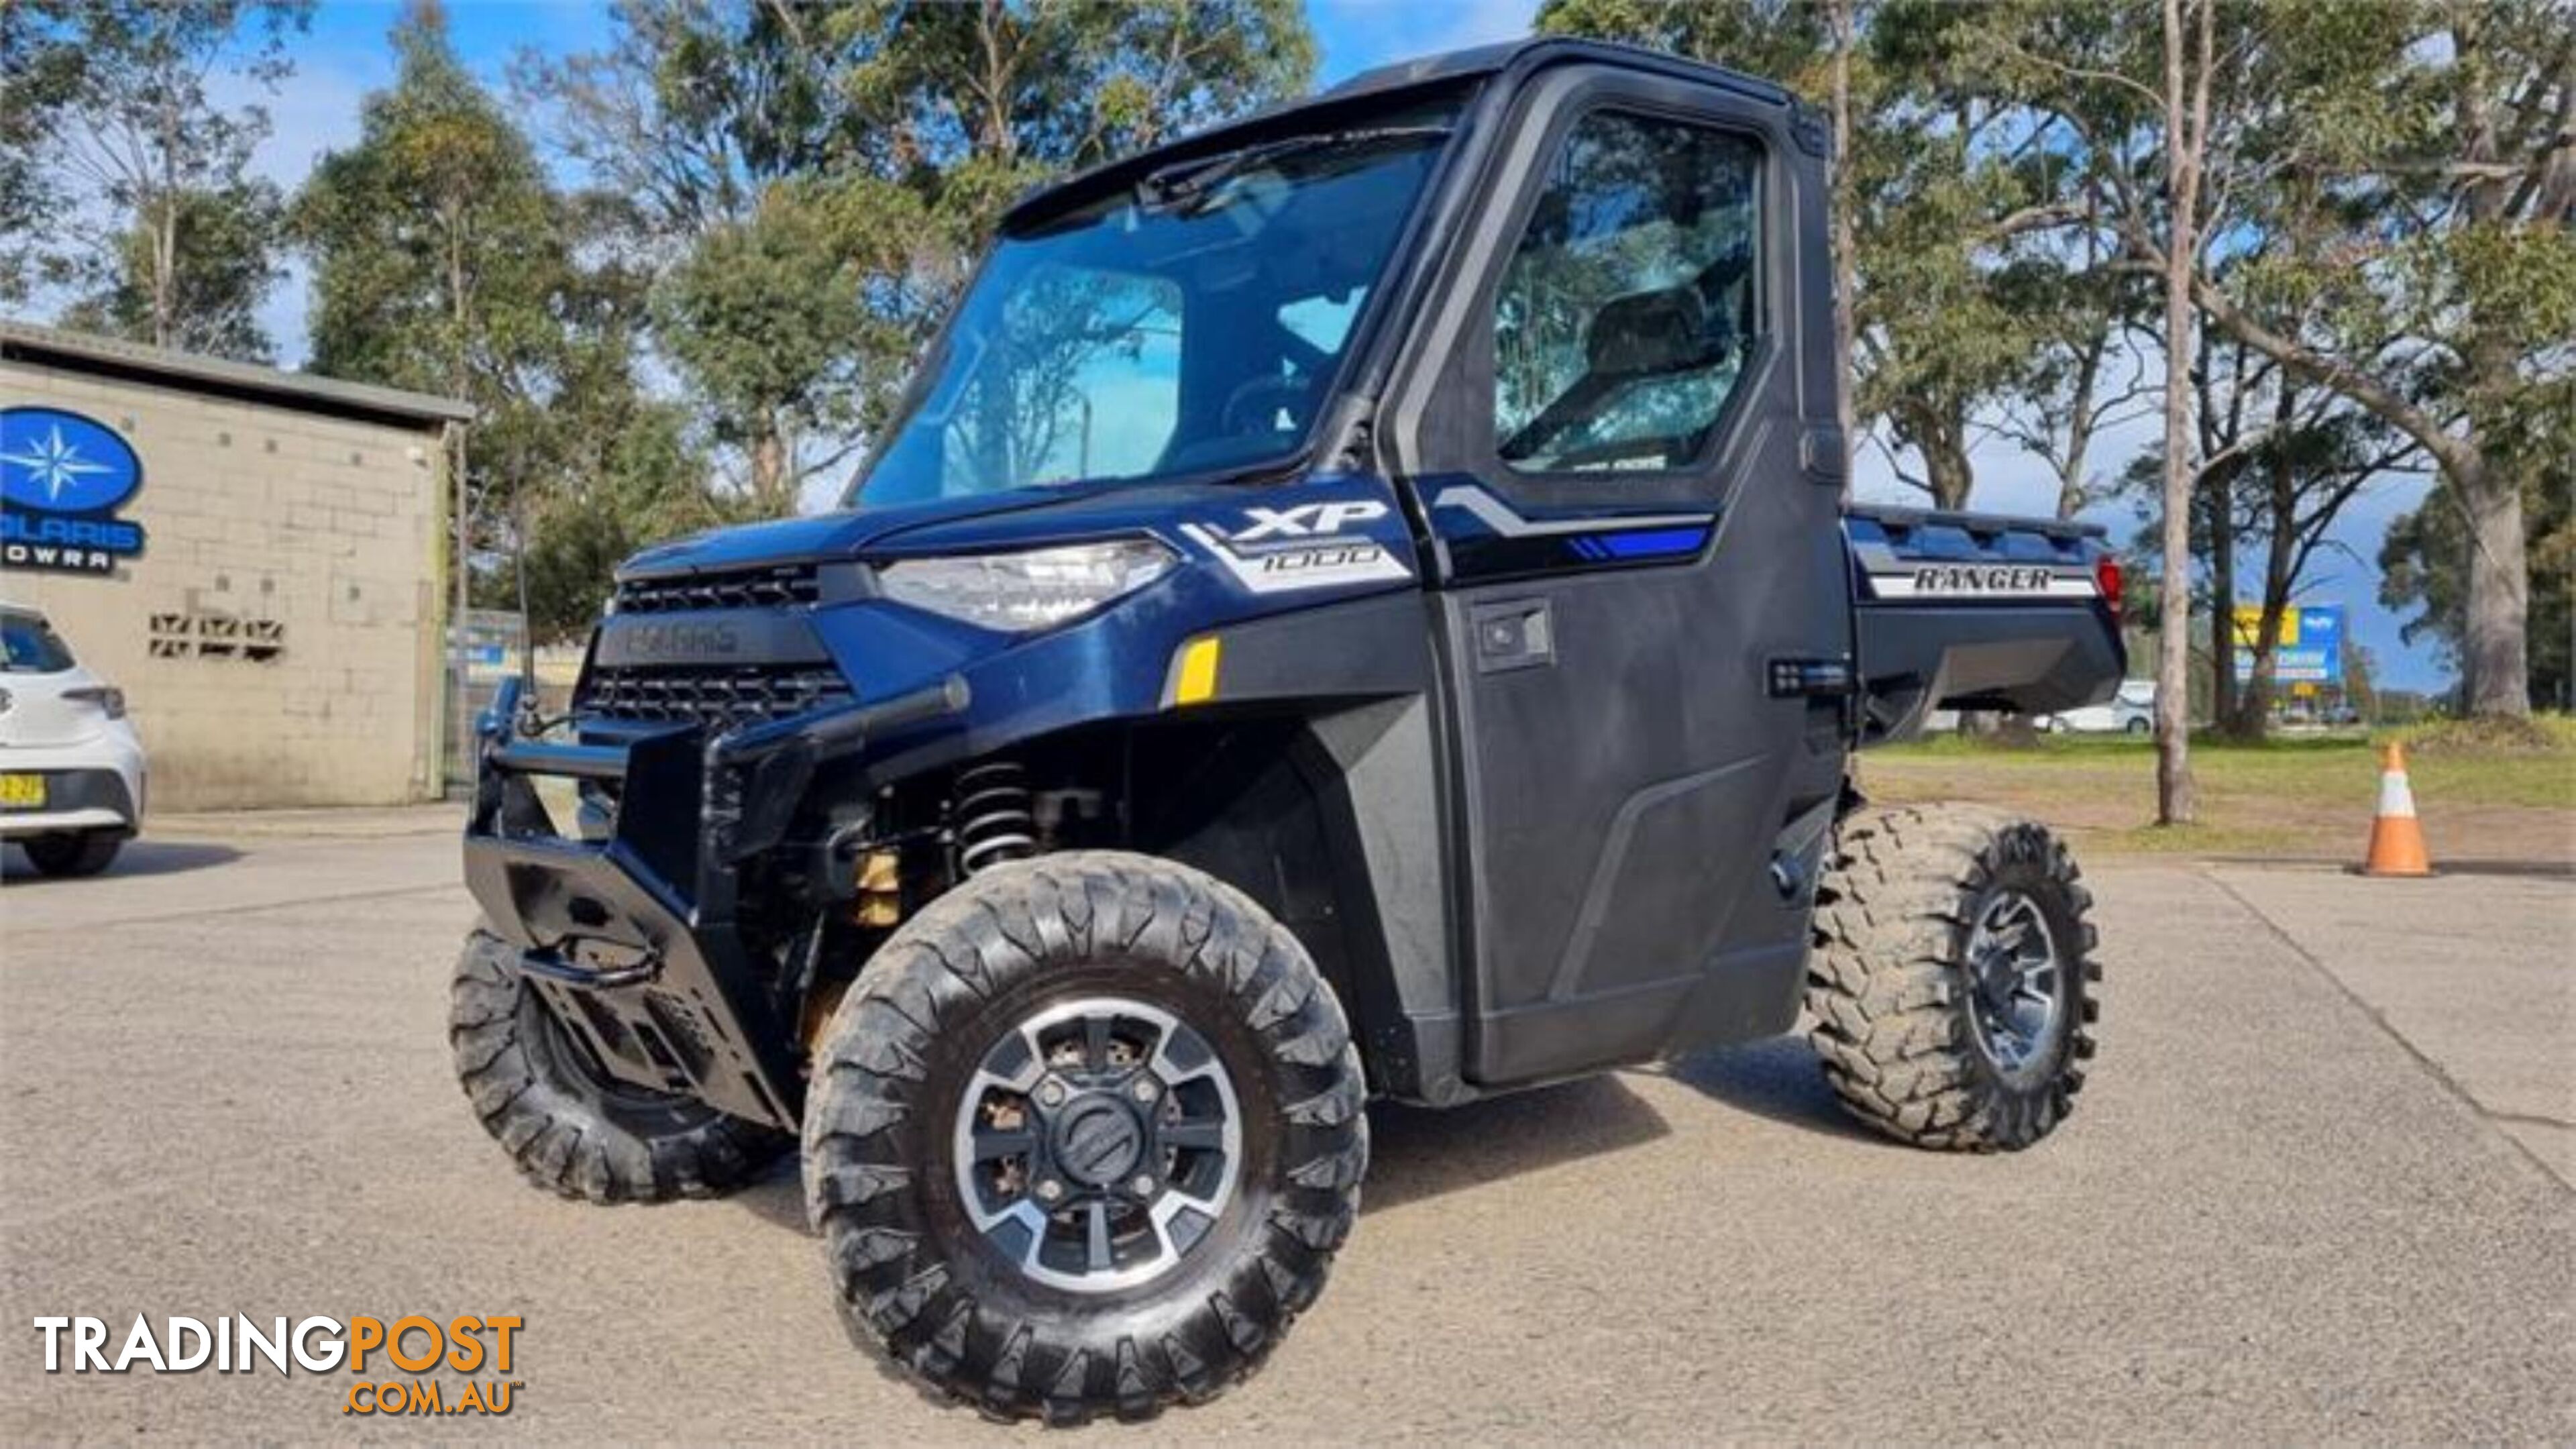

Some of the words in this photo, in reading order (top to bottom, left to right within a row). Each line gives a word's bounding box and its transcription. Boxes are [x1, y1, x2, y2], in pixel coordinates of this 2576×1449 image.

[1230, 501, 1389, 539] XP
[1264, 547, 1381, 572] 1000
[1915, 566, 2052, 590] RANGER
